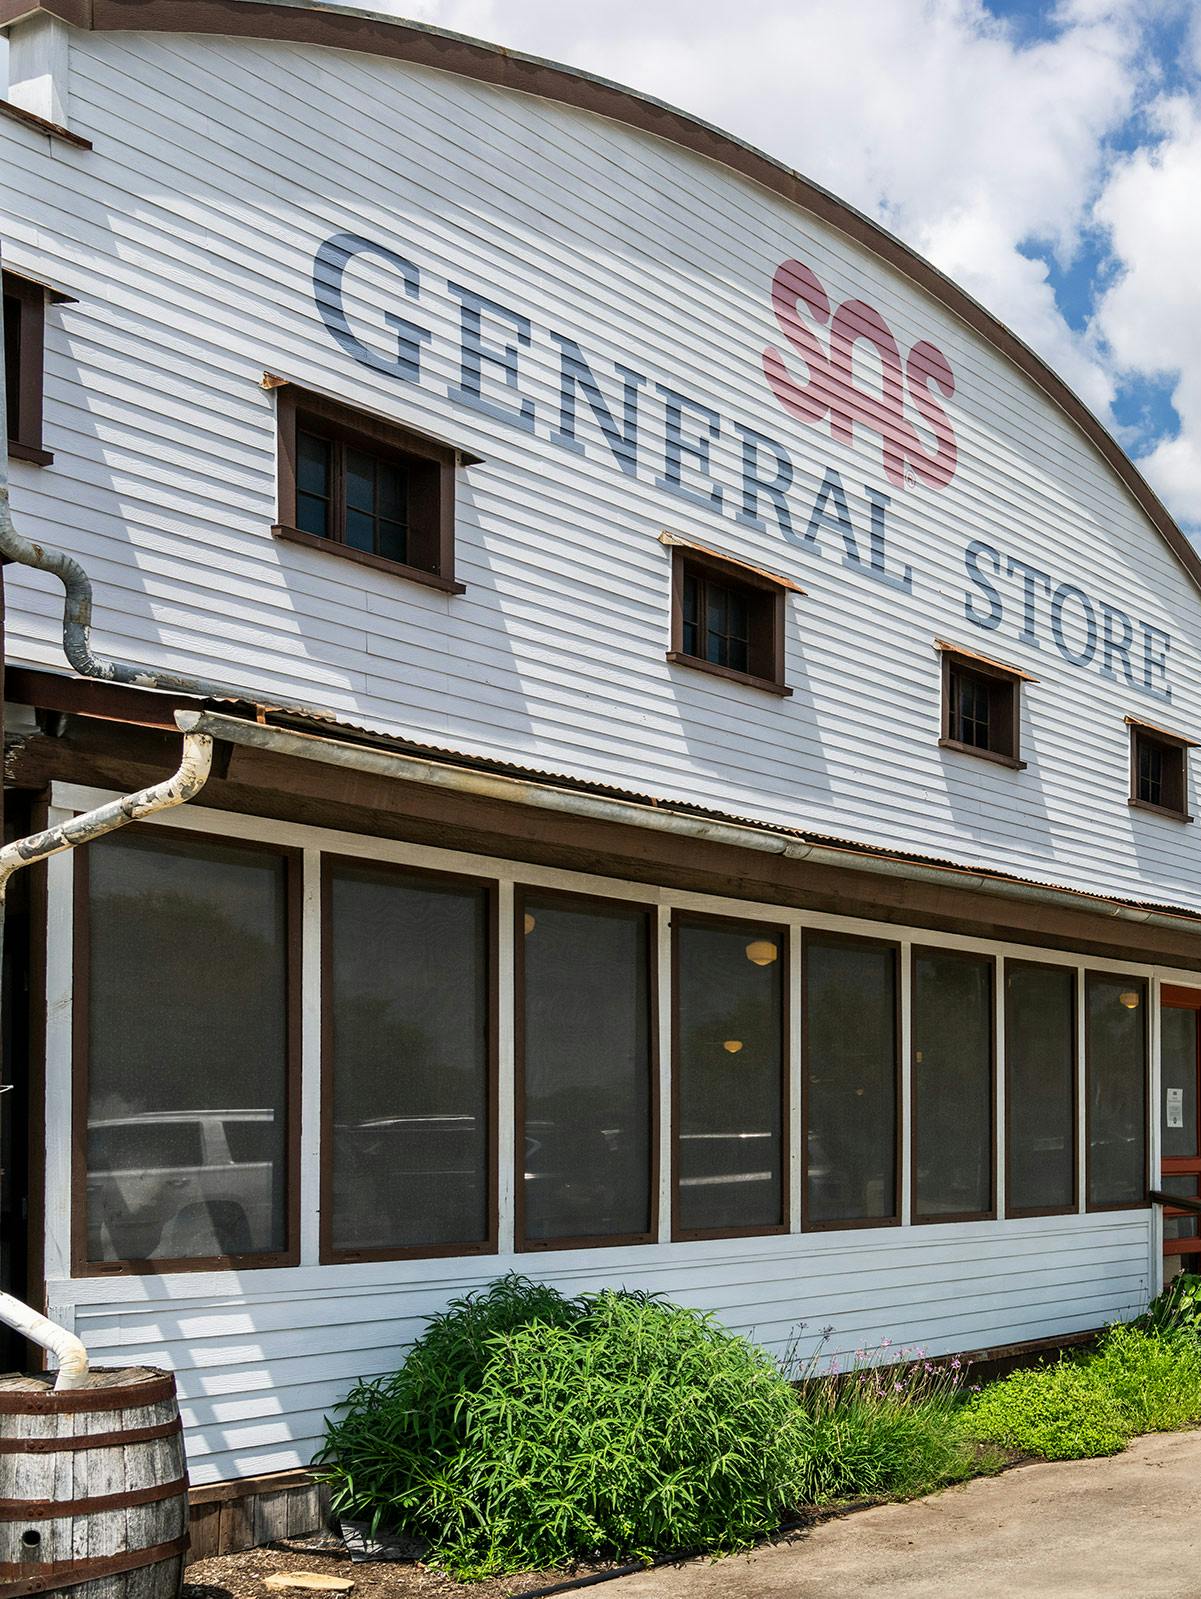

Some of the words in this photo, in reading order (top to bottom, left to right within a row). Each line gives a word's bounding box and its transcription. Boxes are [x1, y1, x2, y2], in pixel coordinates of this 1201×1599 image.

[312, 232, 913, 596] GENERAL
[965, 539, 1173, 704] STORE
[762, 258, 957, 491] SAS
